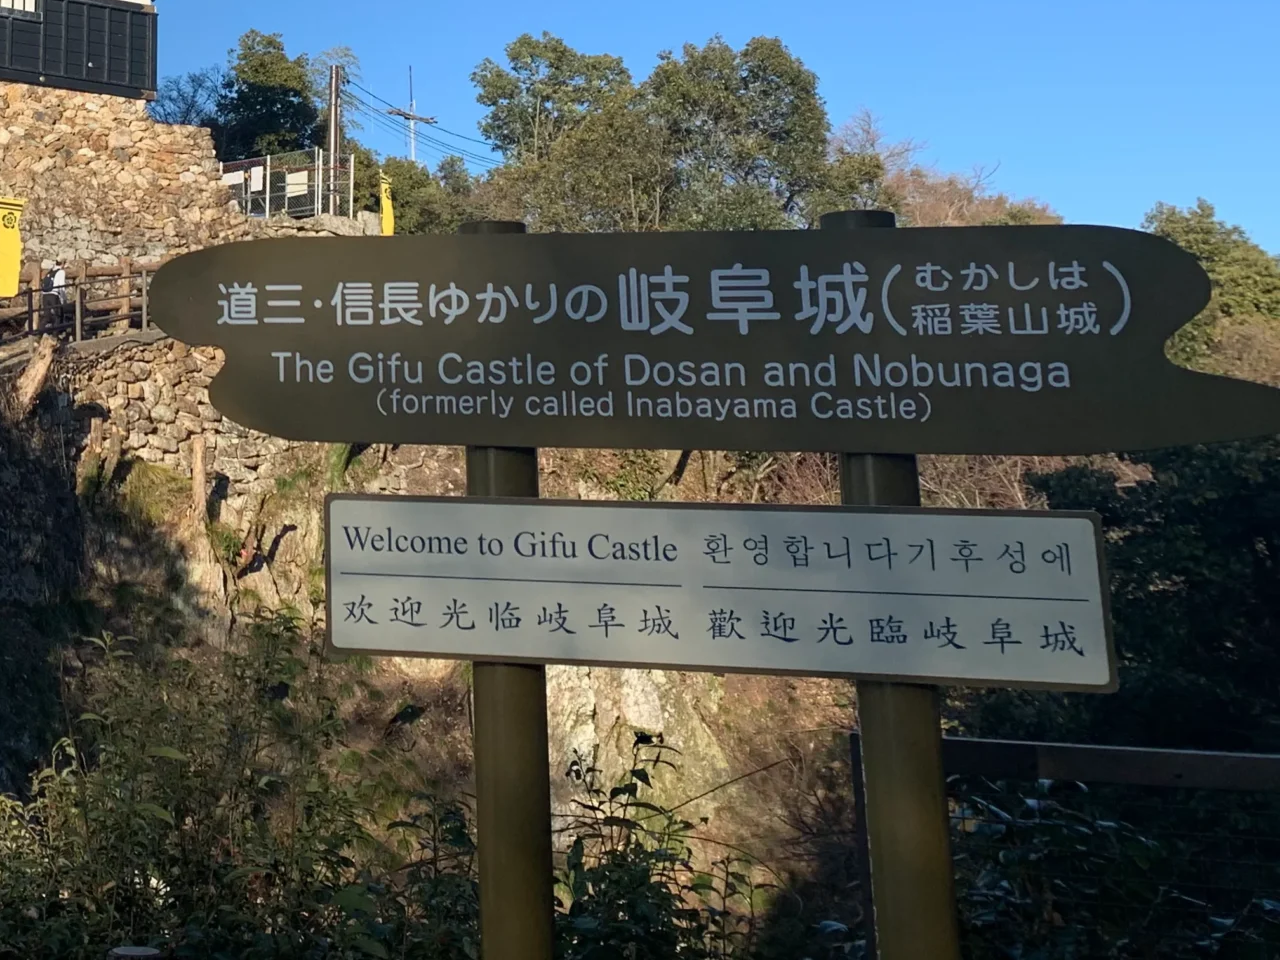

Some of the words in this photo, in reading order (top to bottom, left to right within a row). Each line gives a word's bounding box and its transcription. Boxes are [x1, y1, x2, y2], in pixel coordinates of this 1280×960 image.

[270, 351, 334, 383] The
[348, 351, 423, 384] Gifu
[437, 352, 555, 385] Castle
[570, 353, 609, 386] of
[624, 353, 746, 387] Dosan
[763, 353, 837, 387] and
[853, 353, 1071, 392] Nobunaga
[376, 387, 514, 419] (formerly
[525, 390, 614, 417] called
[627, 390, 797, 422] Inabayama
[810, 391, 932, 423] Castle)
[342, 526, 468, 555] Welcome
[477, 533, 504, 557] to
[513, 531, 578, 559] Gifu
[587, 533, 678, 562] Castle
[343, 594, 680, 640] 欢迎光临岐阜城
[708, 608, 1085, 657] 歡迎光臨岐阜城
